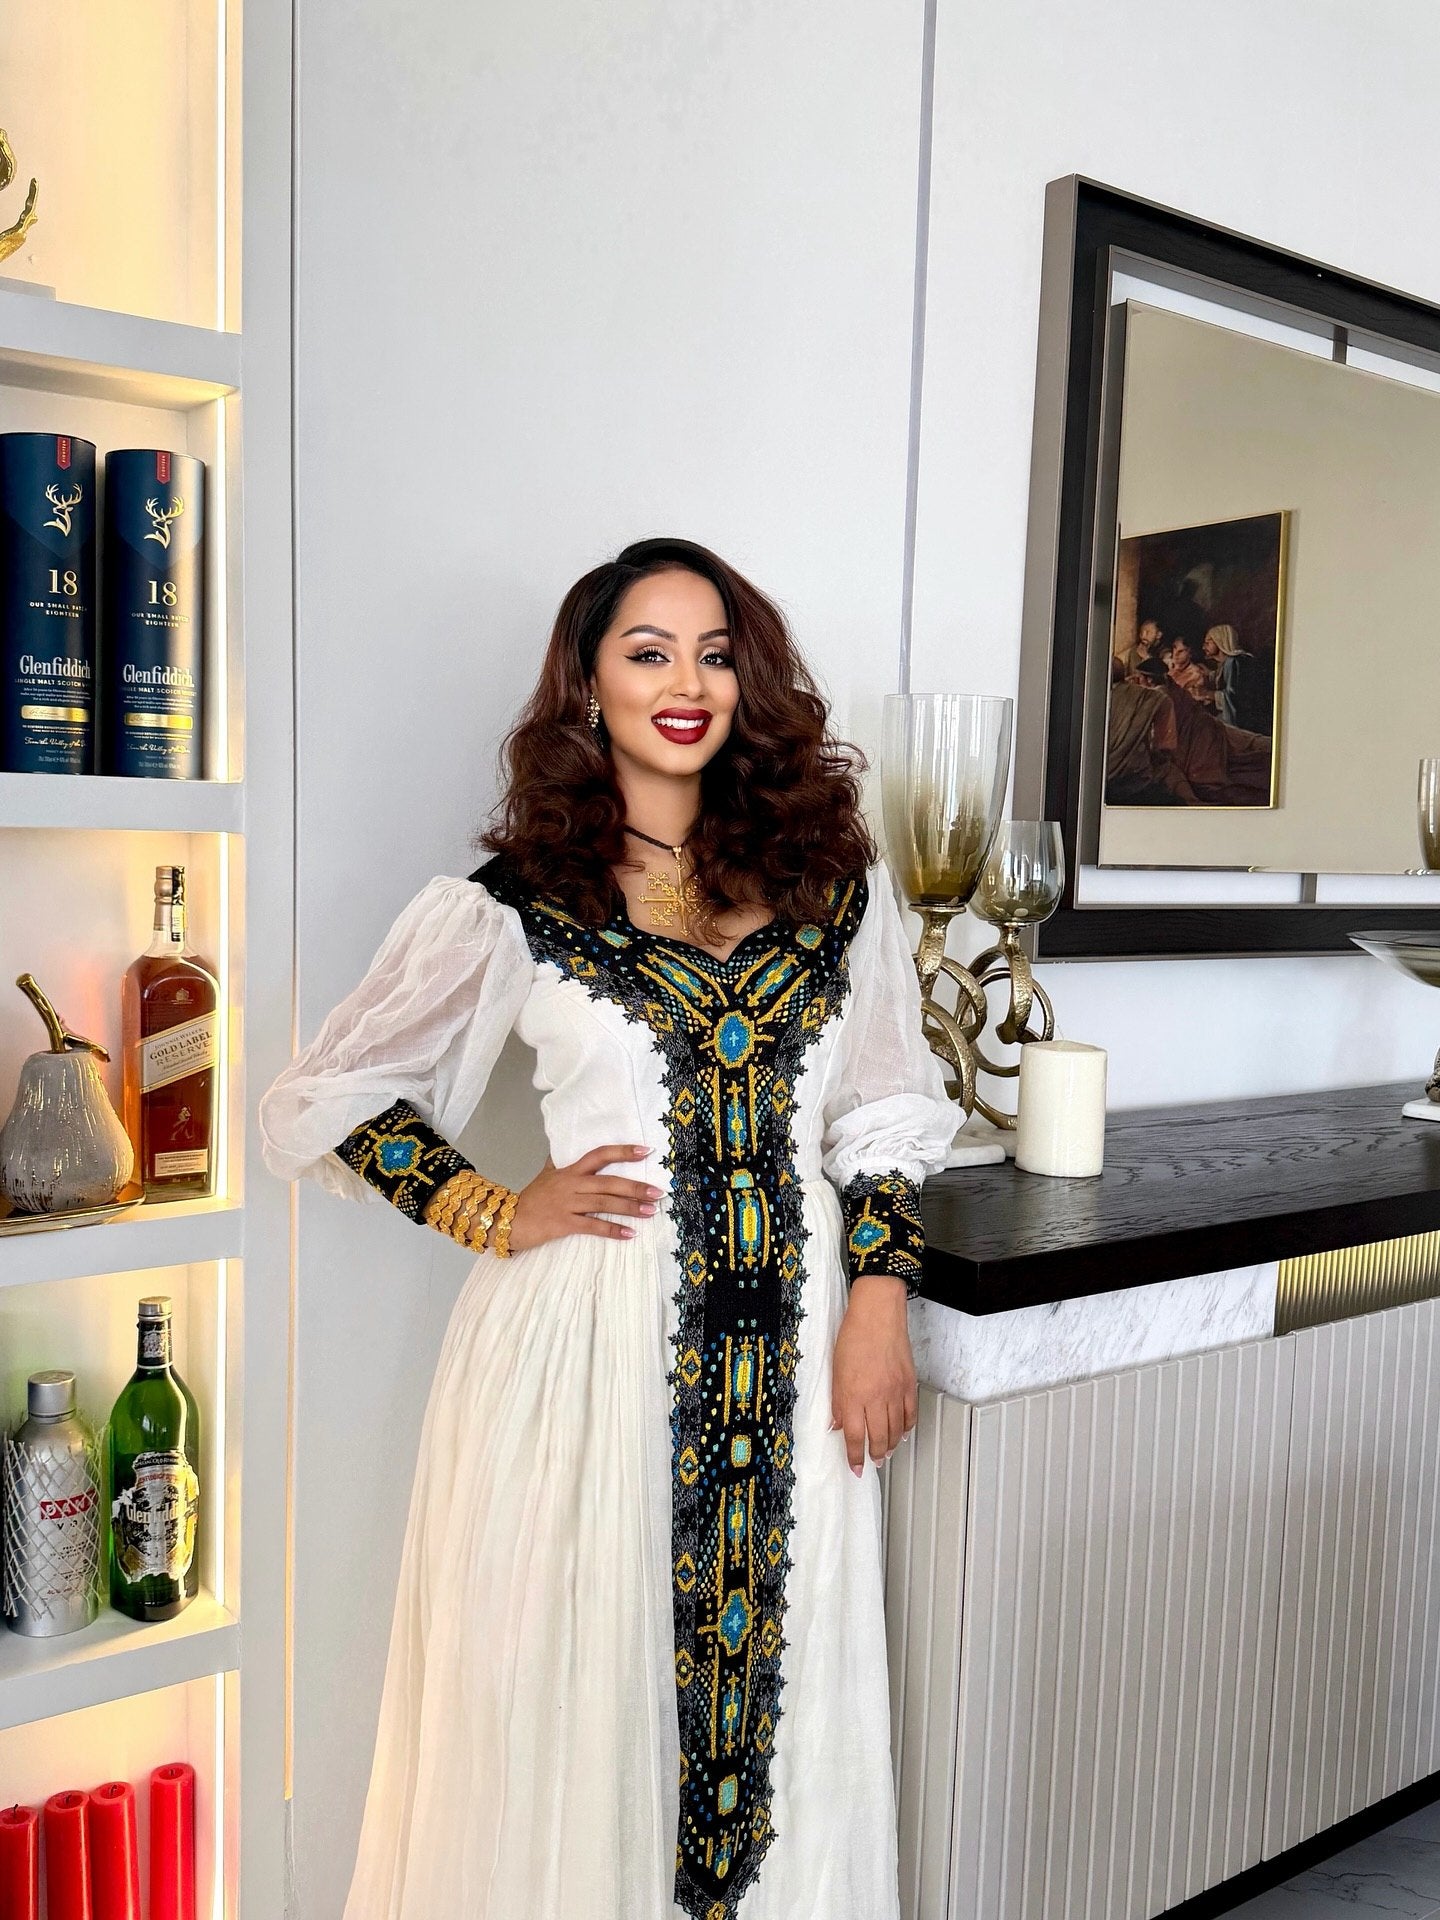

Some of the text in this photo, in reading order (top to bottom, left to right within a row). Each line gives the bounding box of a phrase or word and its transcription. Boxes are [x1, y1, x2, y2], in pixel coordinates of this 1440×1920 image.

[48, 569, 78, 596] 18
[148, 580, 177, 607] 18
[45, 609, 80, 618] EIGHTEEN
[47, 602, 70, 610] SMALL
[146, 612, 168, 620] SMALL
[19, 654, 91, 679] Glenfiddich
[123, 663, 195, 688] Glenfiddich
[37, 678, 55, 686] MALT
[150, 1044, 178, 1060] GOLD
[179, 1031, 212, 1049] LABEL
[156, 1040, 210, 1066] RESERVE
